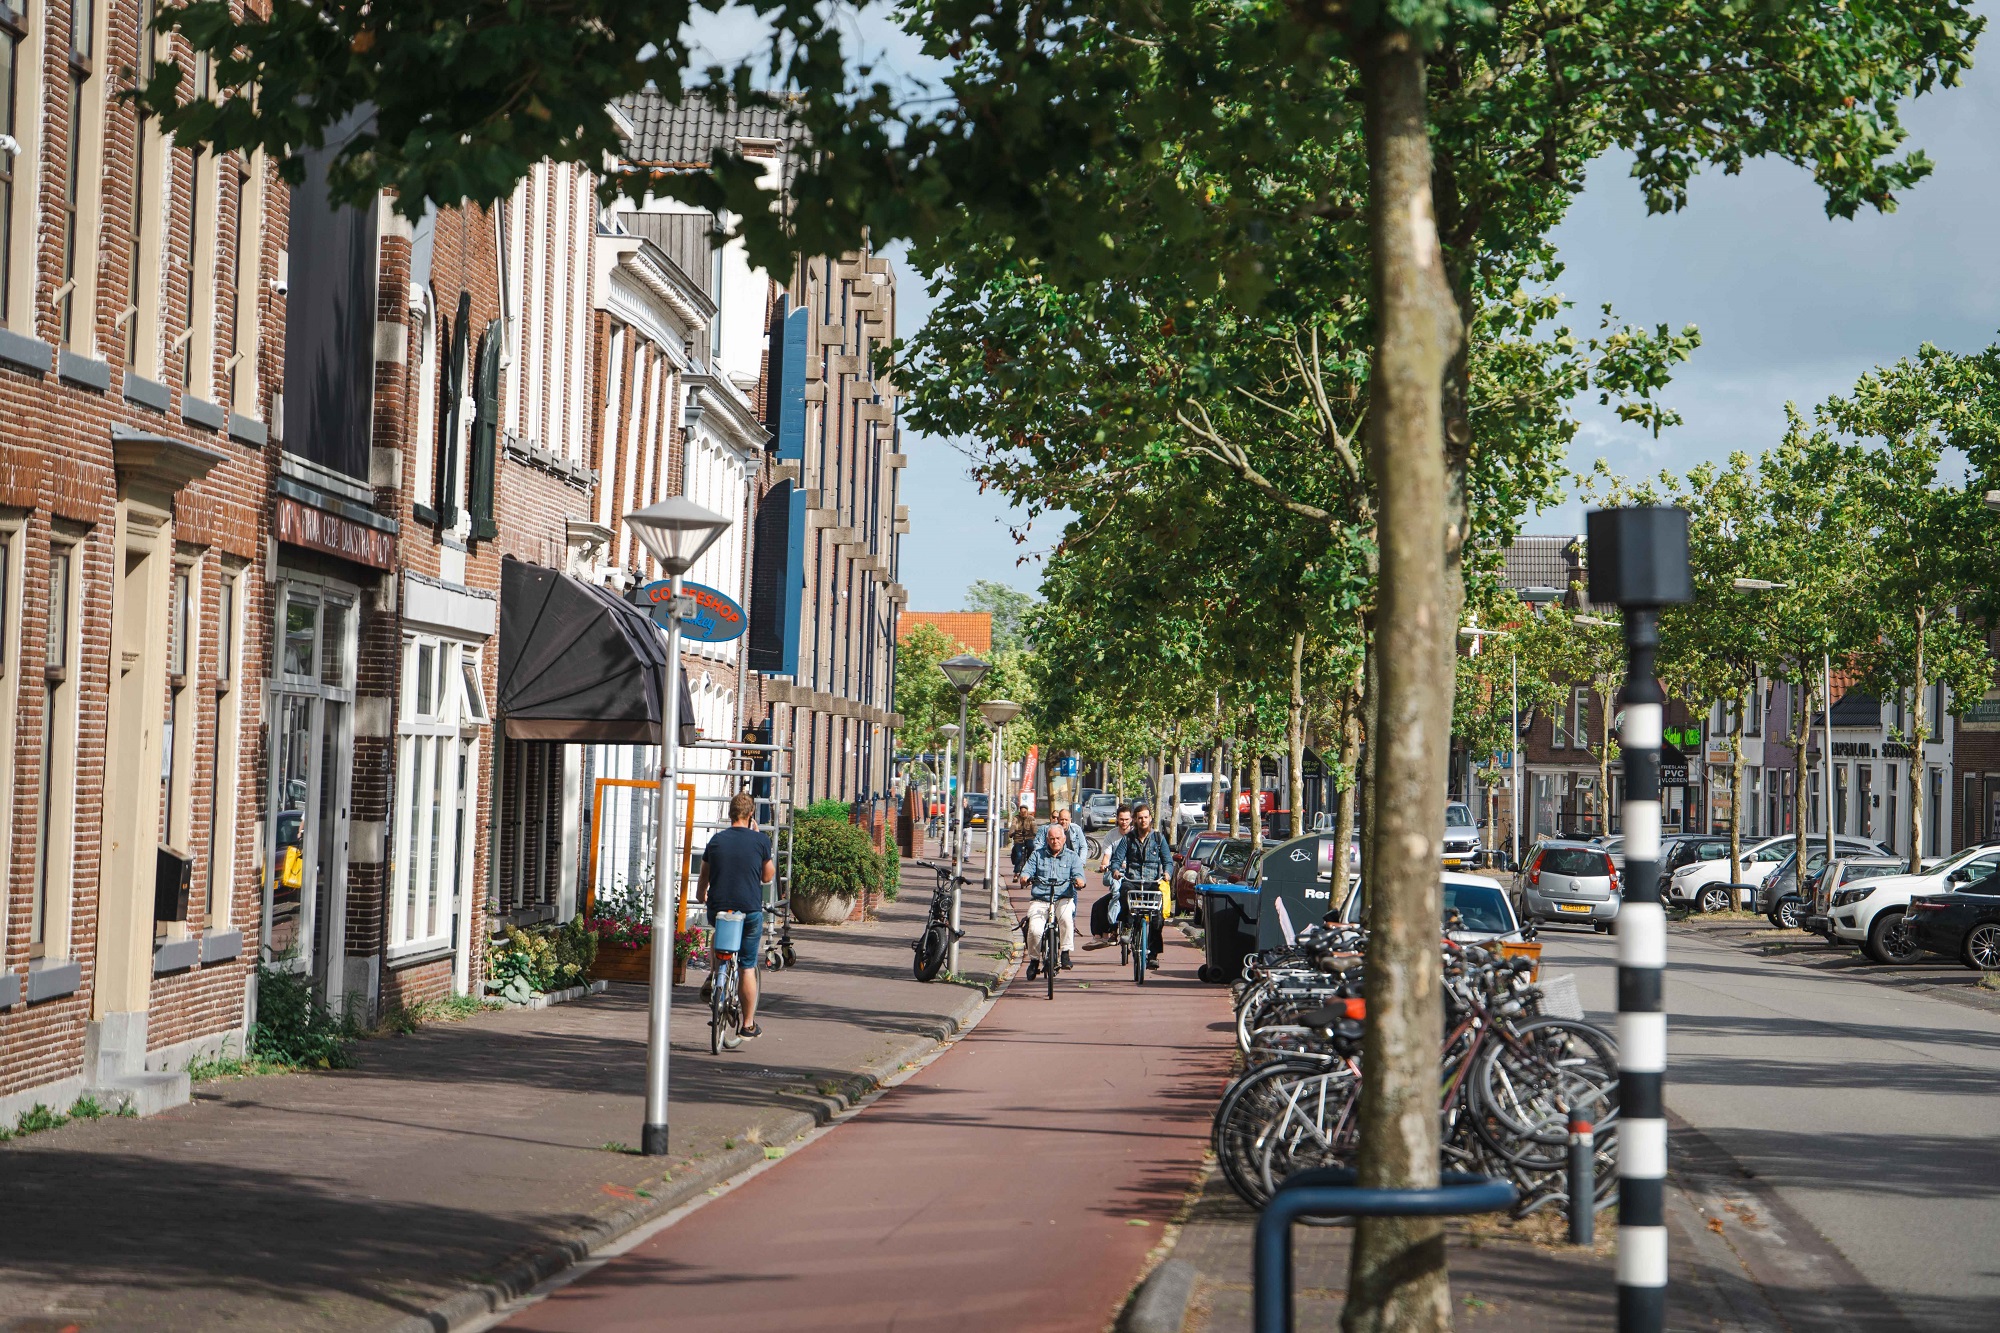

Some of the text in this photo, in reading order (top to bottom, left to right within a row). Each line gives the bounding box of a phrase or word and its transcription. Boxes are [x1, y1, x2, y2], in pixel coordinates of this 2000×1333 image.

[1832, 742, 1870, 756] APSALON
[1070, 760, 1074, 769] P
[1665, 769, 1684, 777] PVC
